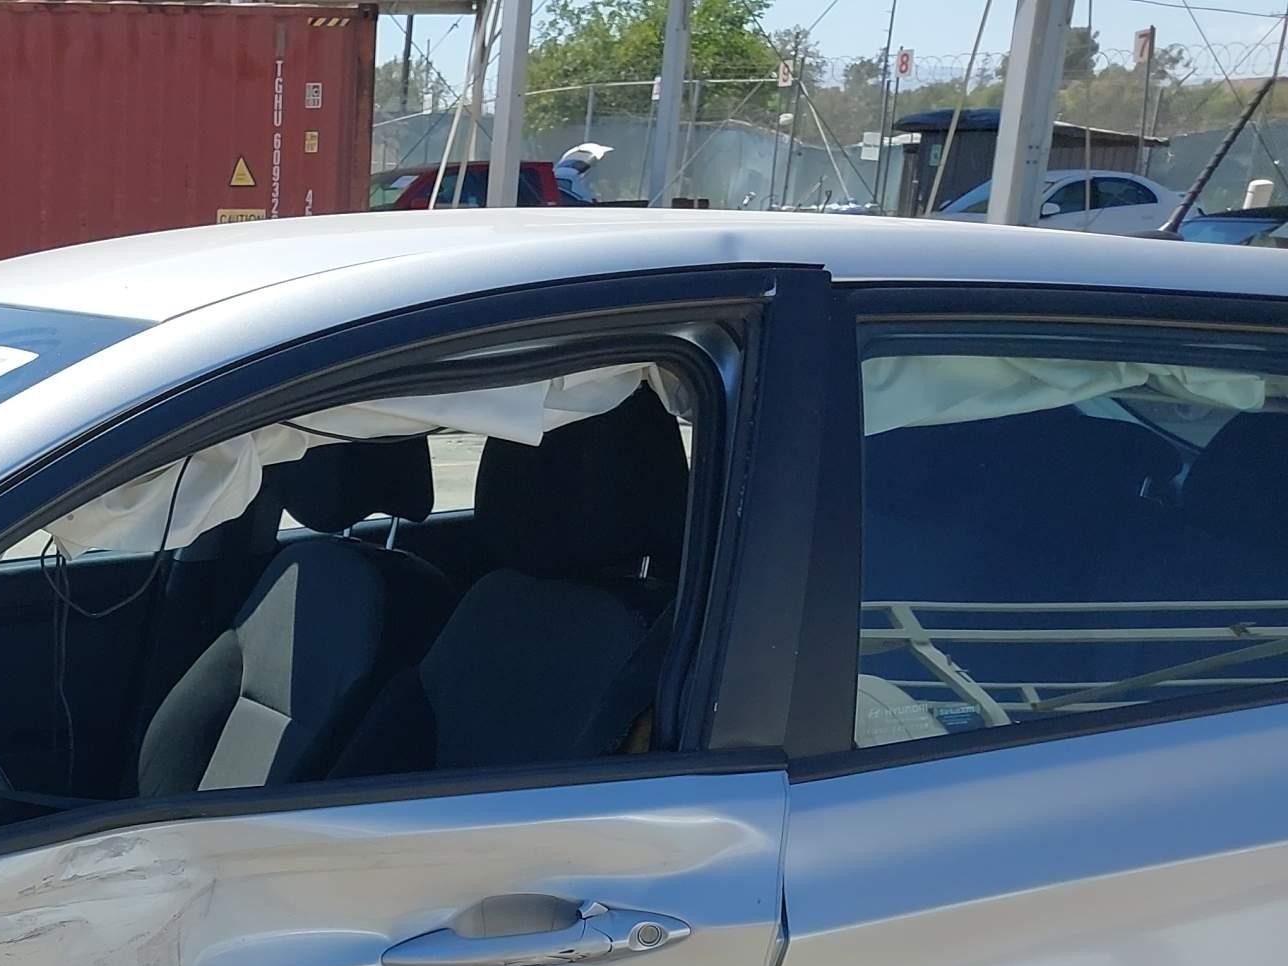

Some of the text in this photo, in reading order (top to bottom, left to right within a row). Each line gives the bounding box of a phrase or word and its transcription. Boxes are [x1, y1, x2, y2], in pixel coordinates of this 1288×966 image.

[781, 64, 792, 83] 9
[898, 53, 909, 74] 8
[271, 60, 283, 219] TGHU 60932
